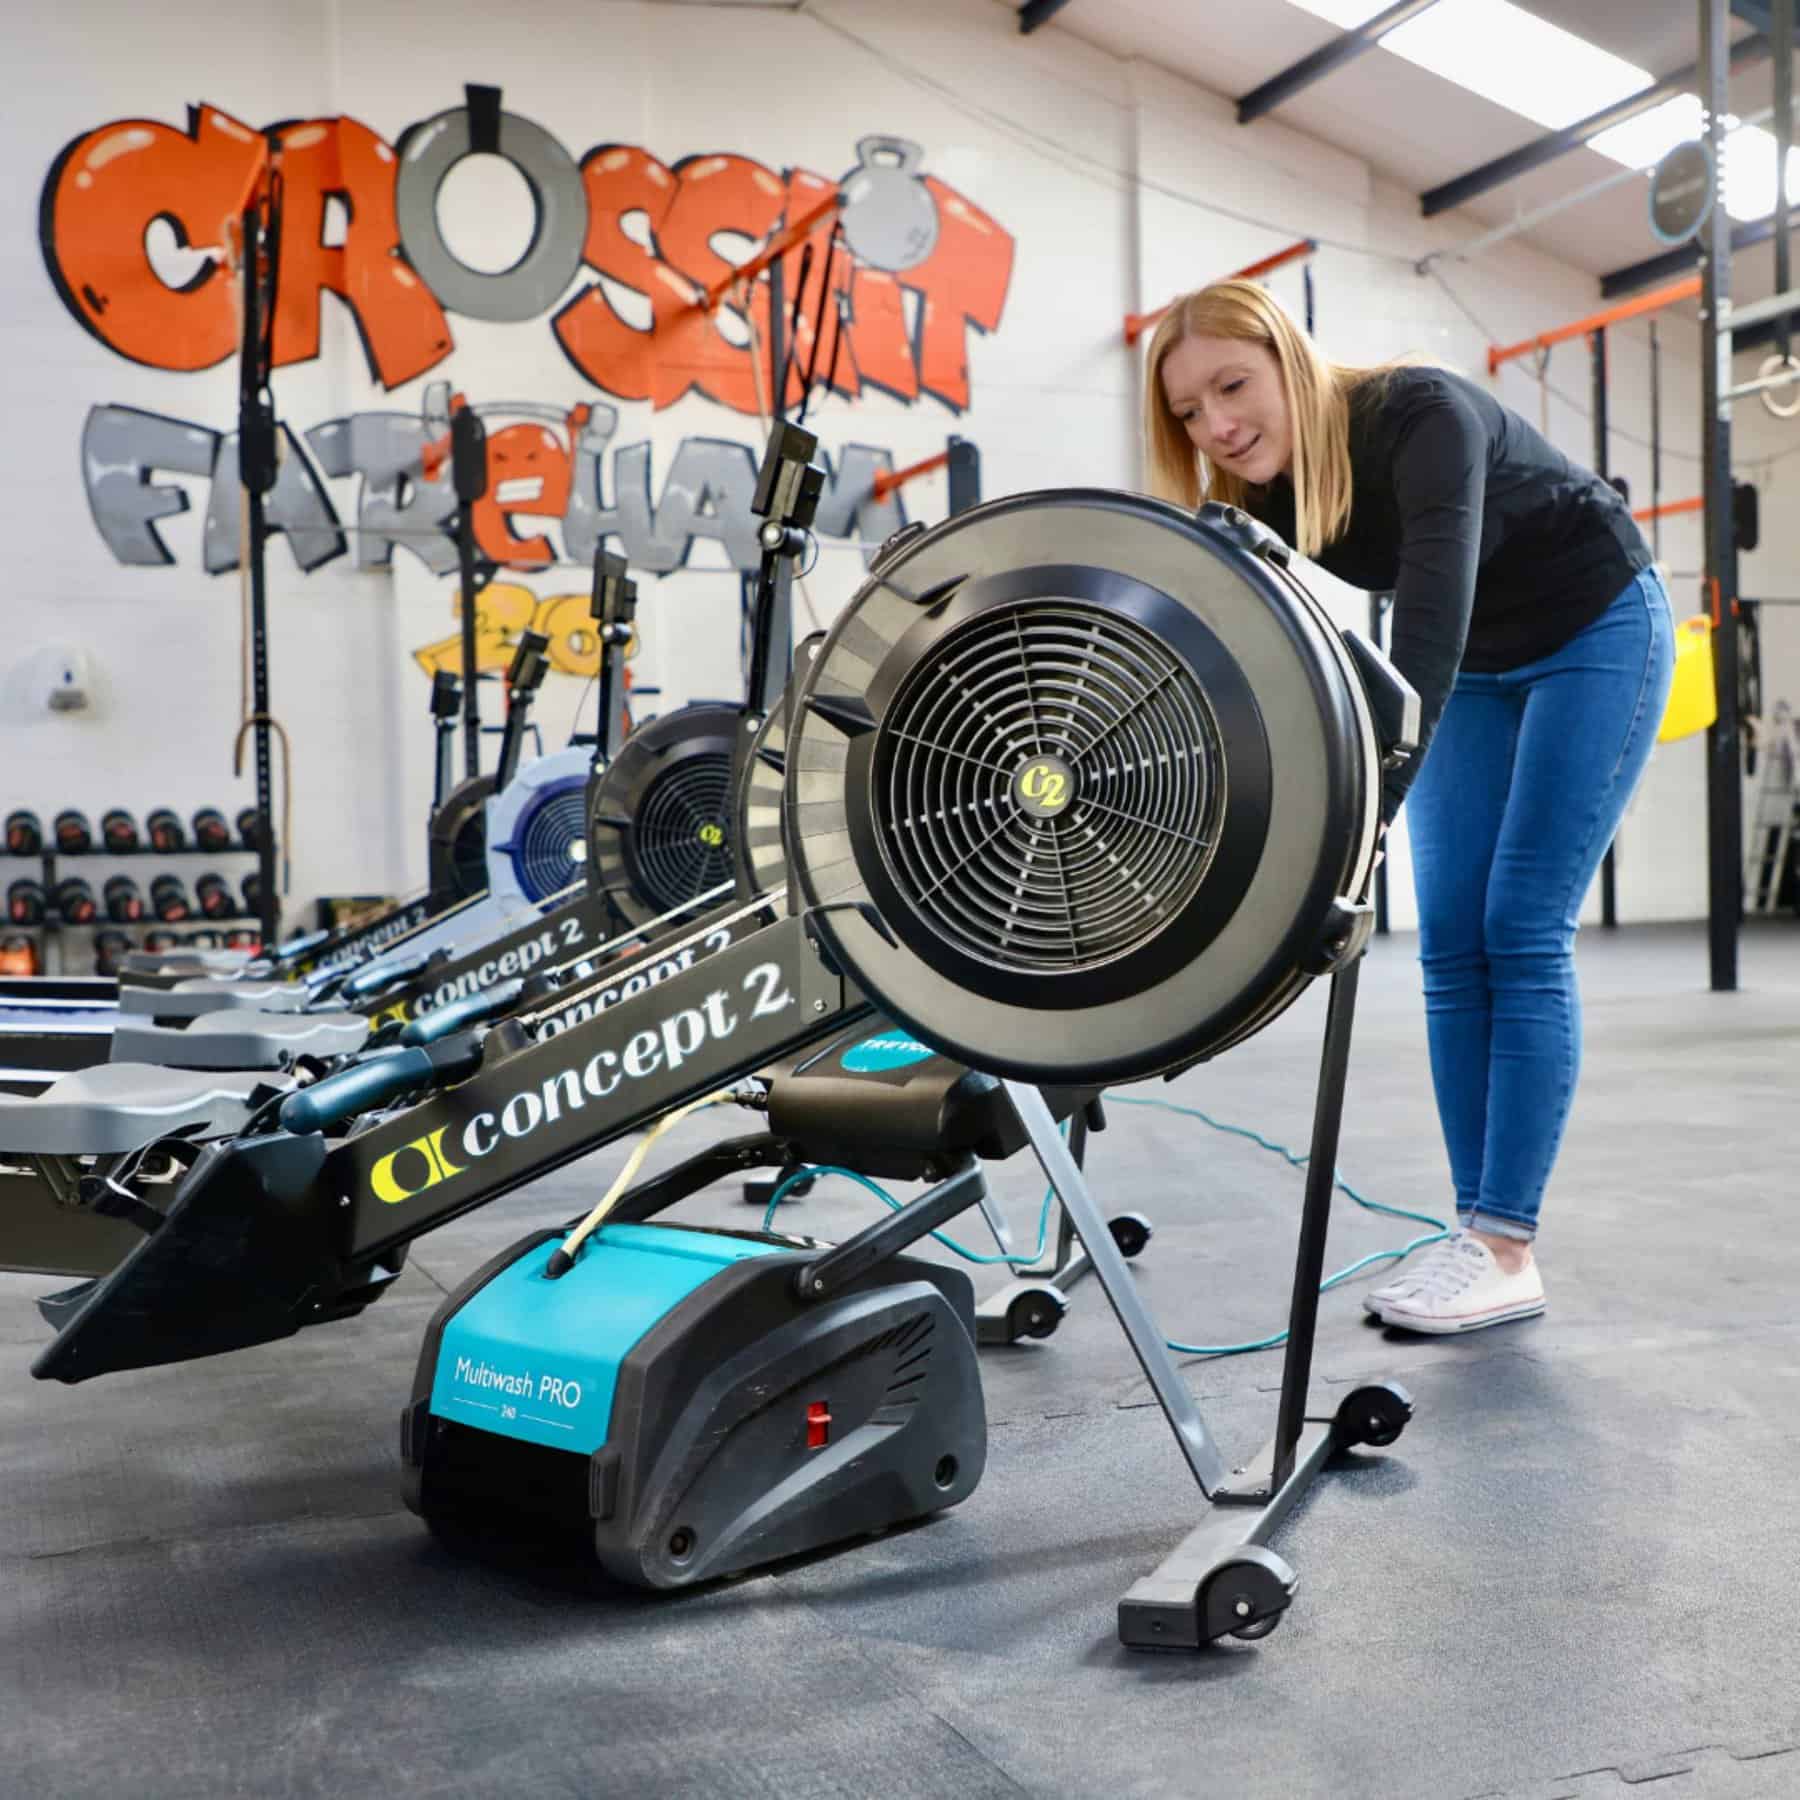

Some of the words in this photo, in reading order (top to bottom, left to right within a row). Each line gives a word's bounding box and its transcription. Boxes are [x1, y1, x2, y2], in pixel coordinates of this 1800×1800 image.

[413, 929, 558, 1018] concept
[559, 917, 584, 945] 2
[462, 988, 738, 1157] concept
[743, 962, 790, 1021] 2
[454, 1355, 533, 1399] Multiwash
[537, 1375, 582, 1409] PRO
